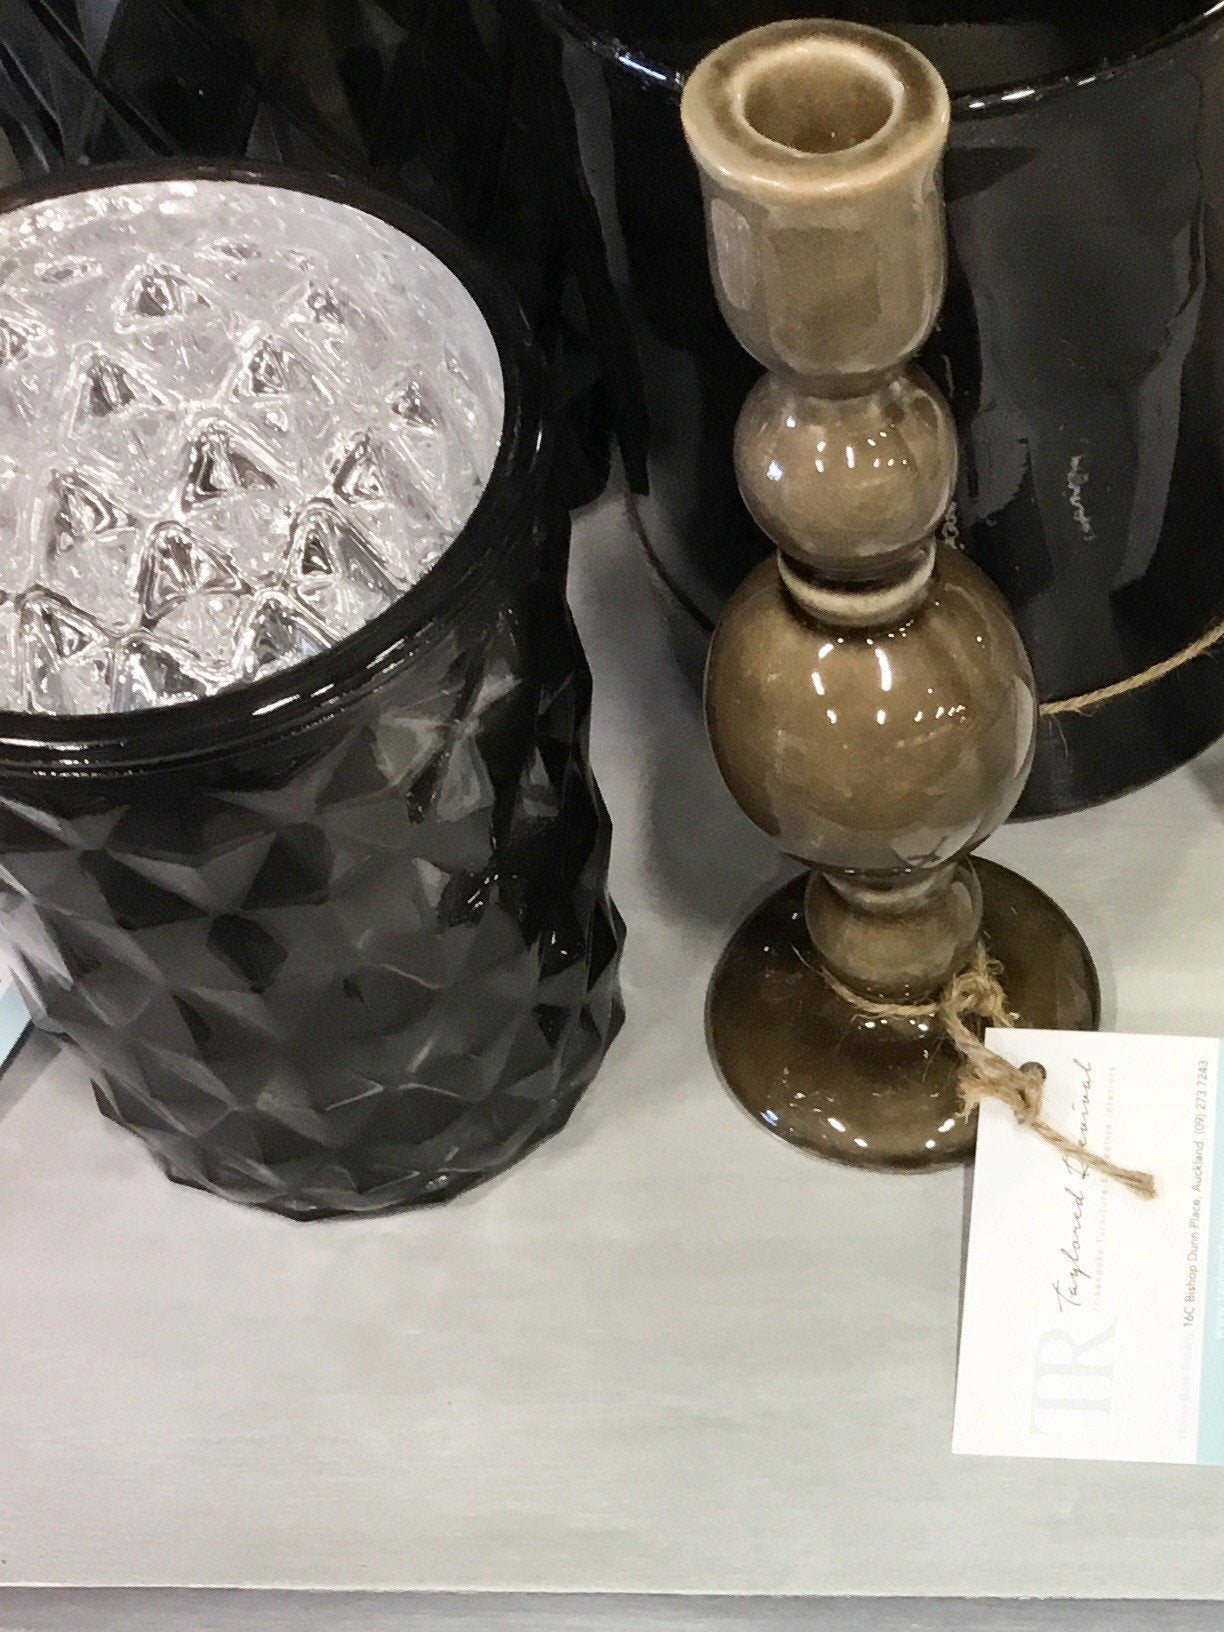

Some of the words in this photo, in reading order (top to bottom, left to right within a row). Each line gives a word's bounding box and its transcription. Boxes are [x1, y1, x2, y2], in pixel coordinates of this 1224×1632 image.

[1197, 1060, 1209, 1087] 7243
[1195, 1091, 1207, 1110] 273
[1195, 1113, 1206, 1135] (09)
[1052, 1186, 1092, 1313] Taylored
[1187, 1230, 1199, 1261] Dunn
[1184, 1265, 1199, 1302] Bishop
[1183, 1306, 1195, 1328] 16C
[1029, 1314, 1119, 1436] TR
